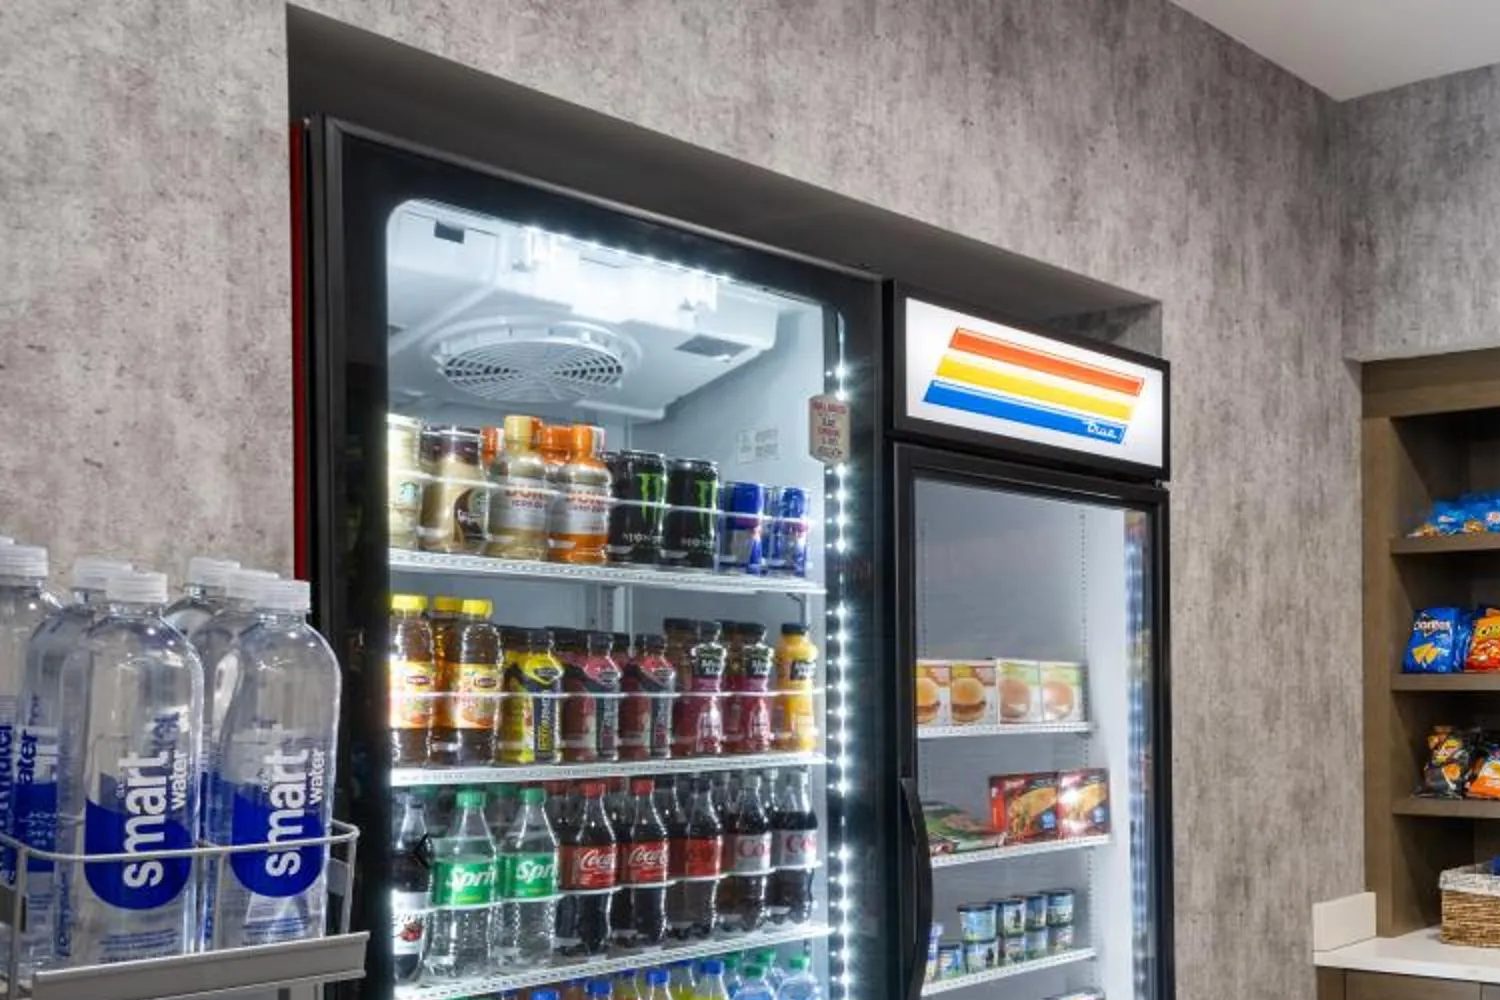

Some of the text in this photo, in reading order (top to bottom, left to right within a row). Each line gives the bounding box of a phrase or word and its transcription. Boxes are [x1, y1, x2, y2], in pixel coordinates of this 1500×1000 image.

[118, 751, 168, 887] smart
[170, 750, 188, 811] water
[263, 749, 308, 877] smart
[309, 749, 325, 806] water
